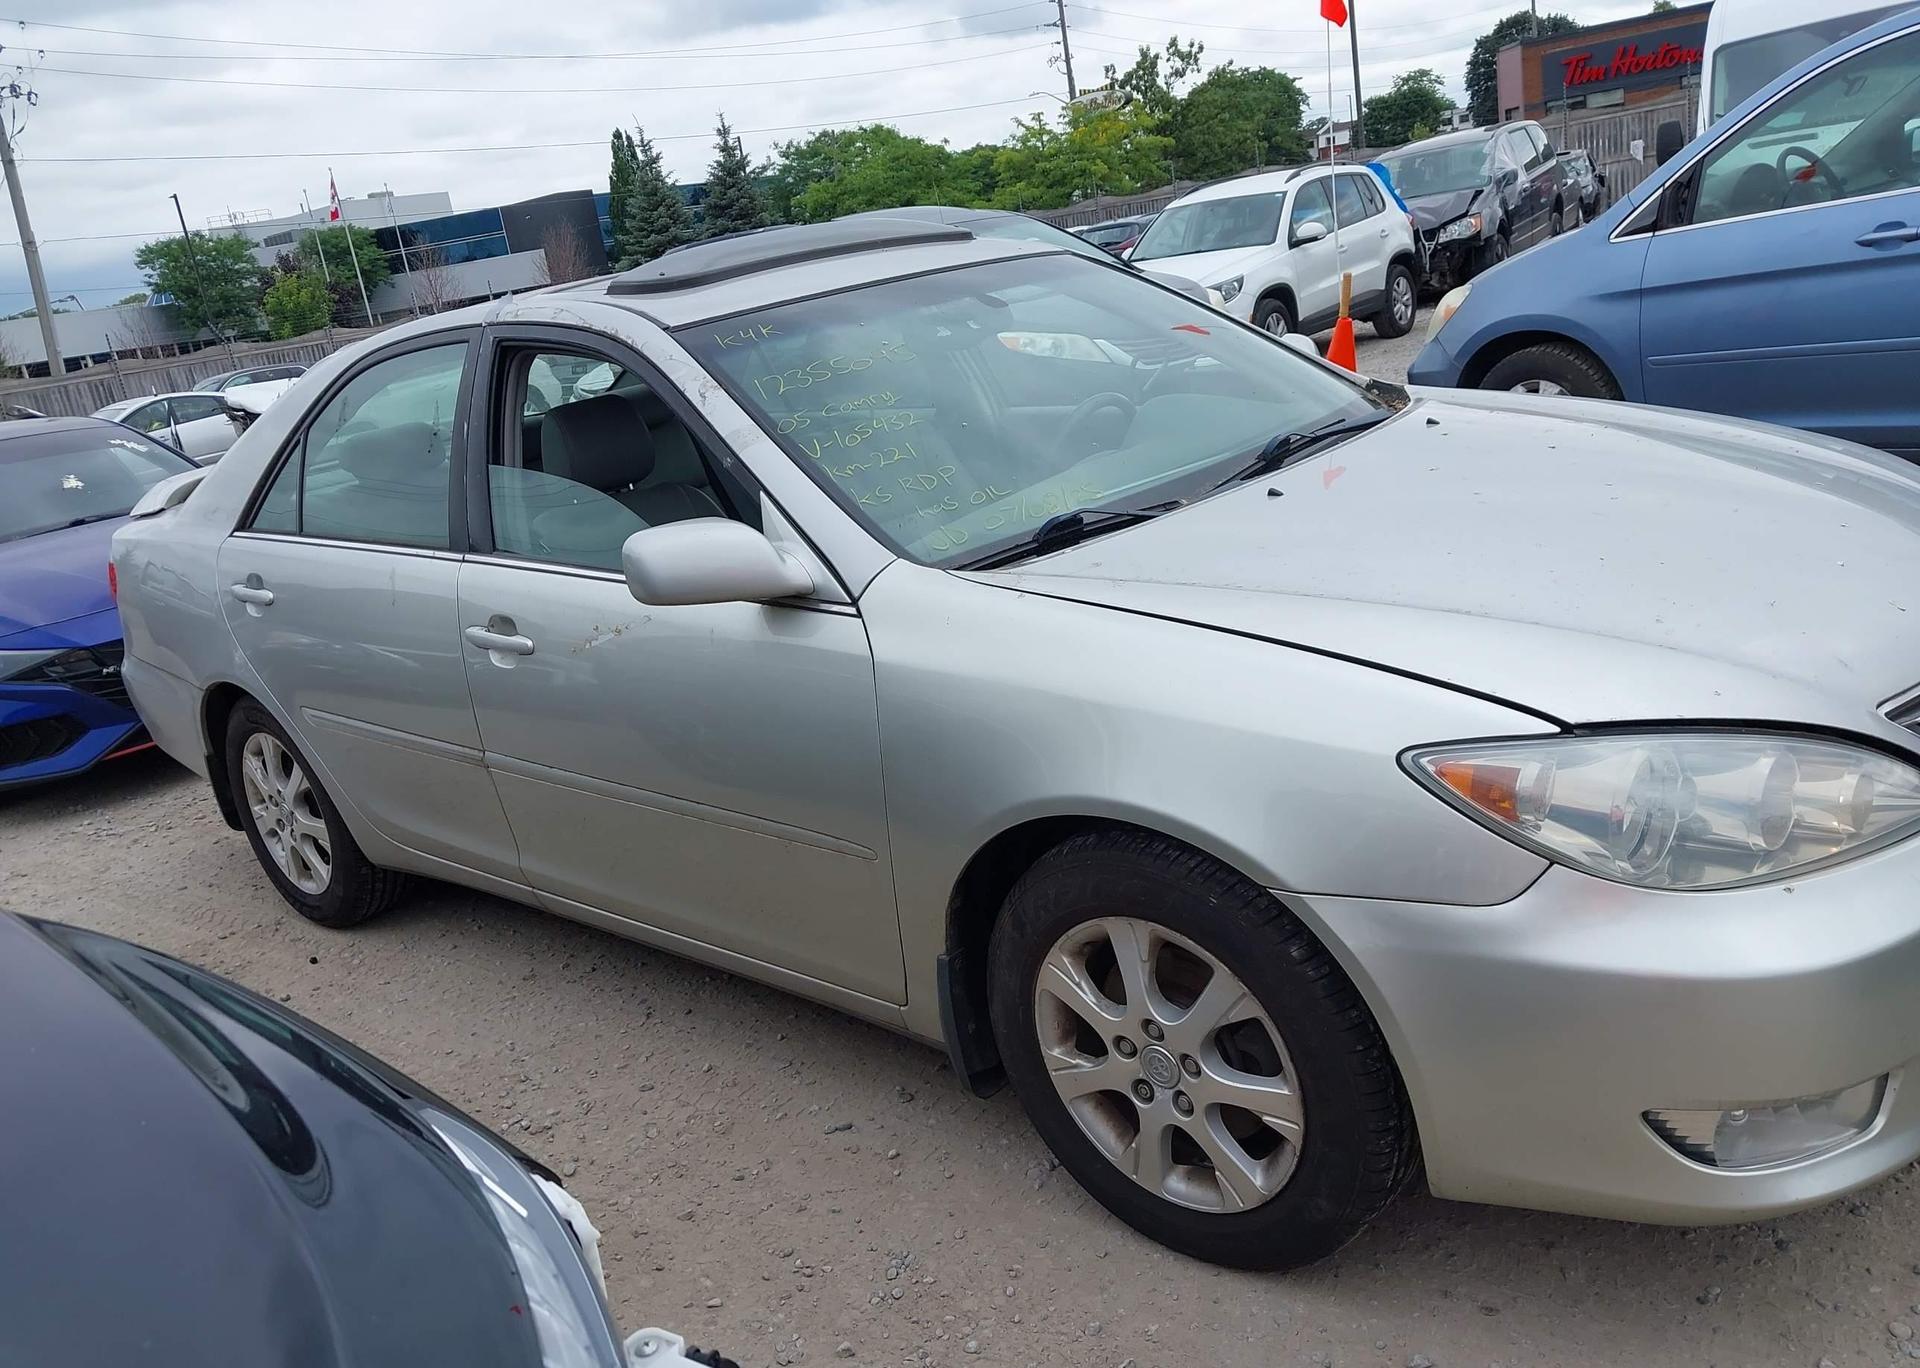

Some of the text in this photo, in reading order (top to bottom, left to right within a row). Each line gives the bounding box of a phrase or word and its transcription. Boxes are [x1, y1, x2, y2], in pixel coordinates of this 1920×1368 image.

[1561, 51, 1606, 88] Tim
[777, 408, 811, 435] 05
[897, 465, 956, 494] RDP
[915, 495, 959, 517] has
